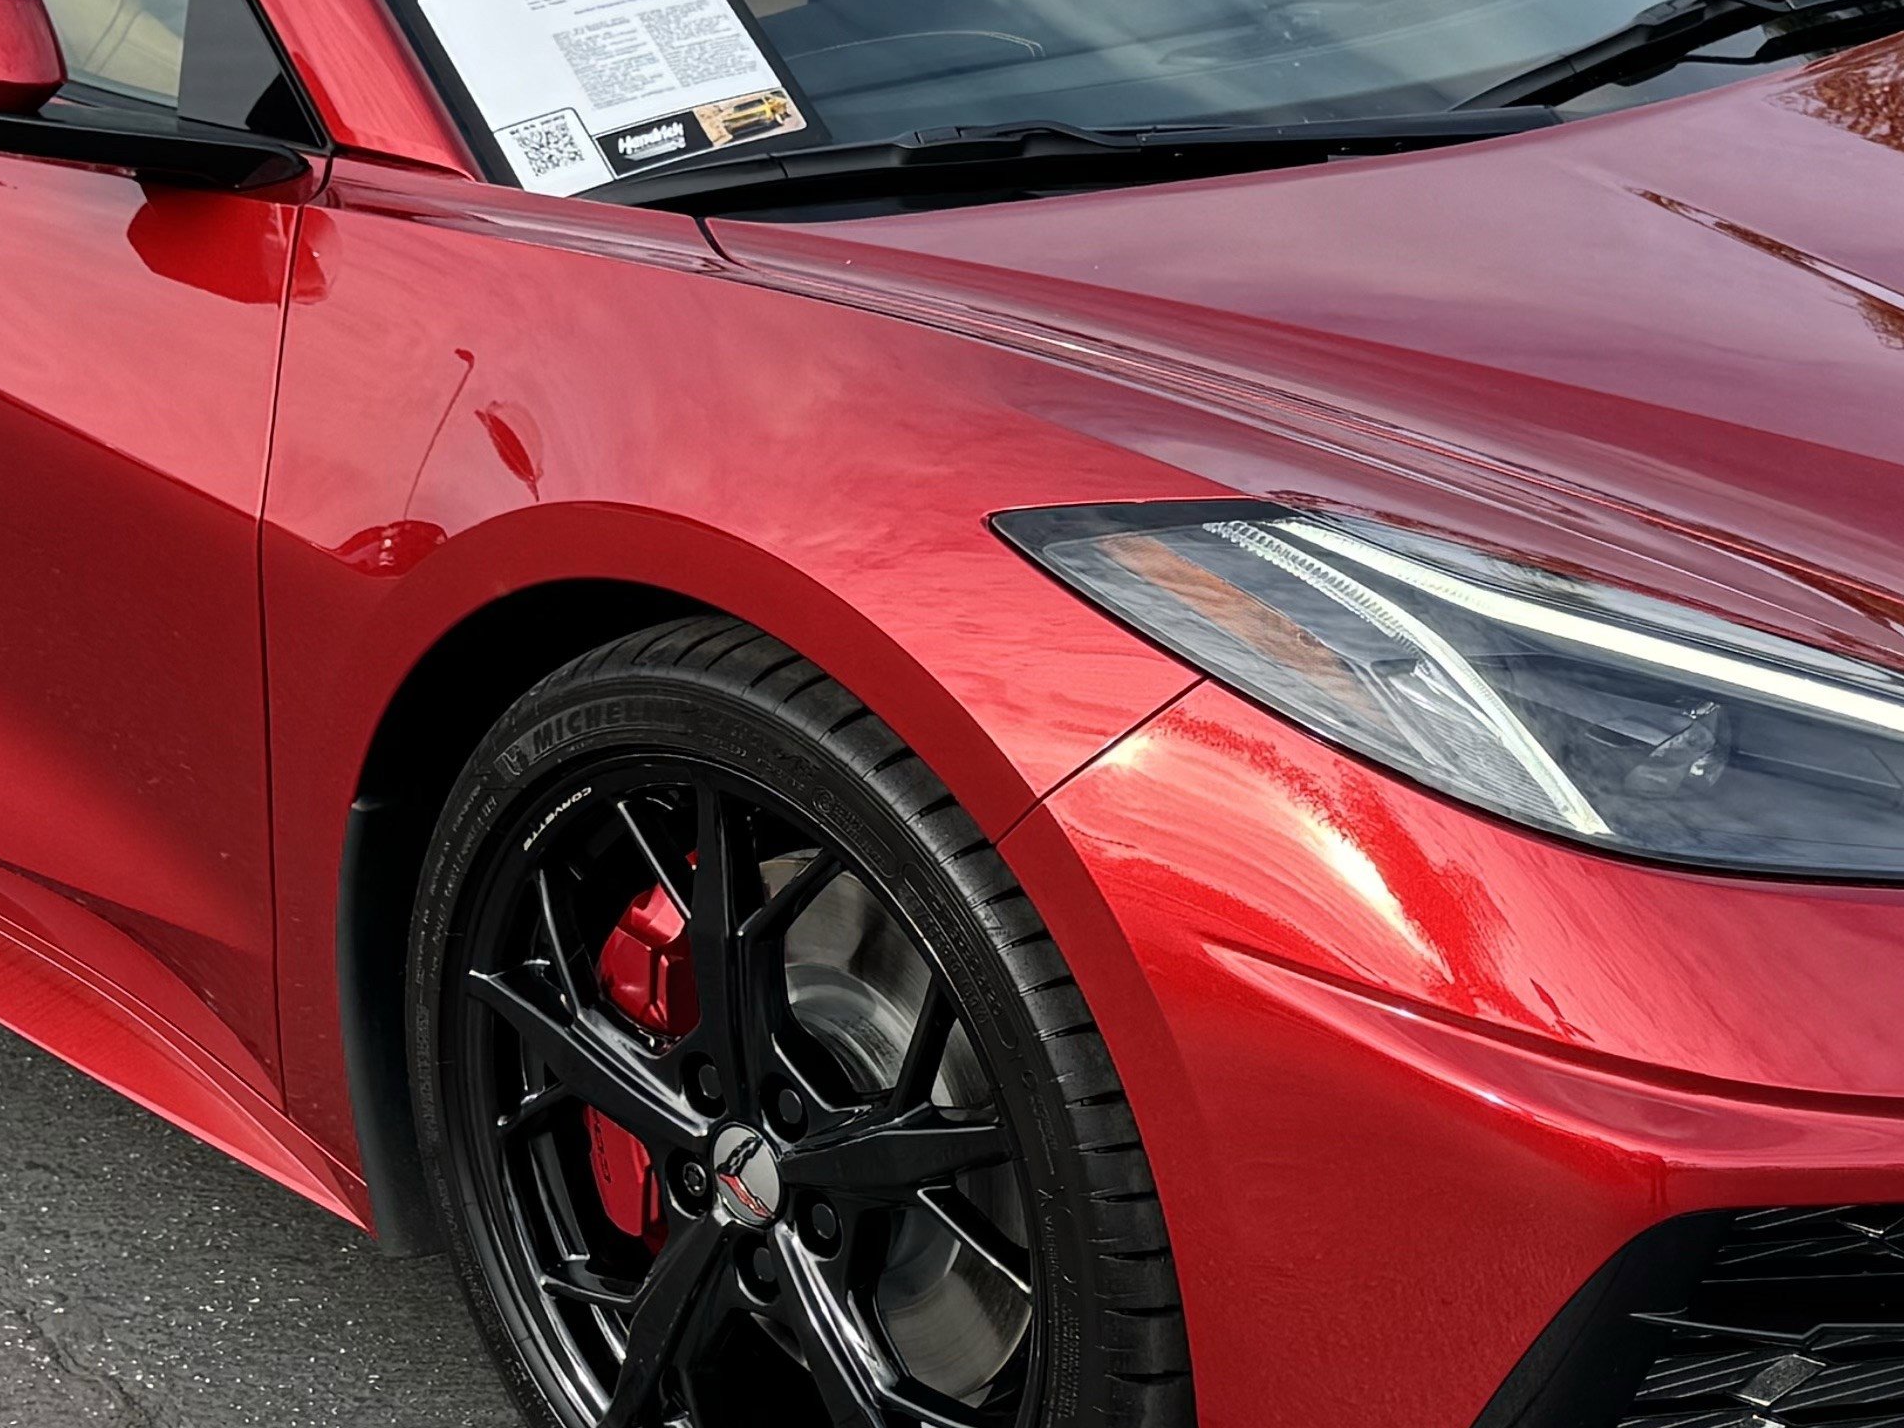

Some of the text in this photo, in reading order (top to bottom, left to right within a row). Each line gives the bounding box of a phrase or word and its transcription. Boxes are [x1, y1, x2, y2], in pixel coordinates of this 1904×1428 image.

[617, 121, 686, 155] Hendrick
[532, 698, 686, 754] MICHELIN
[523, 786, 592, 852] CORVETTE
